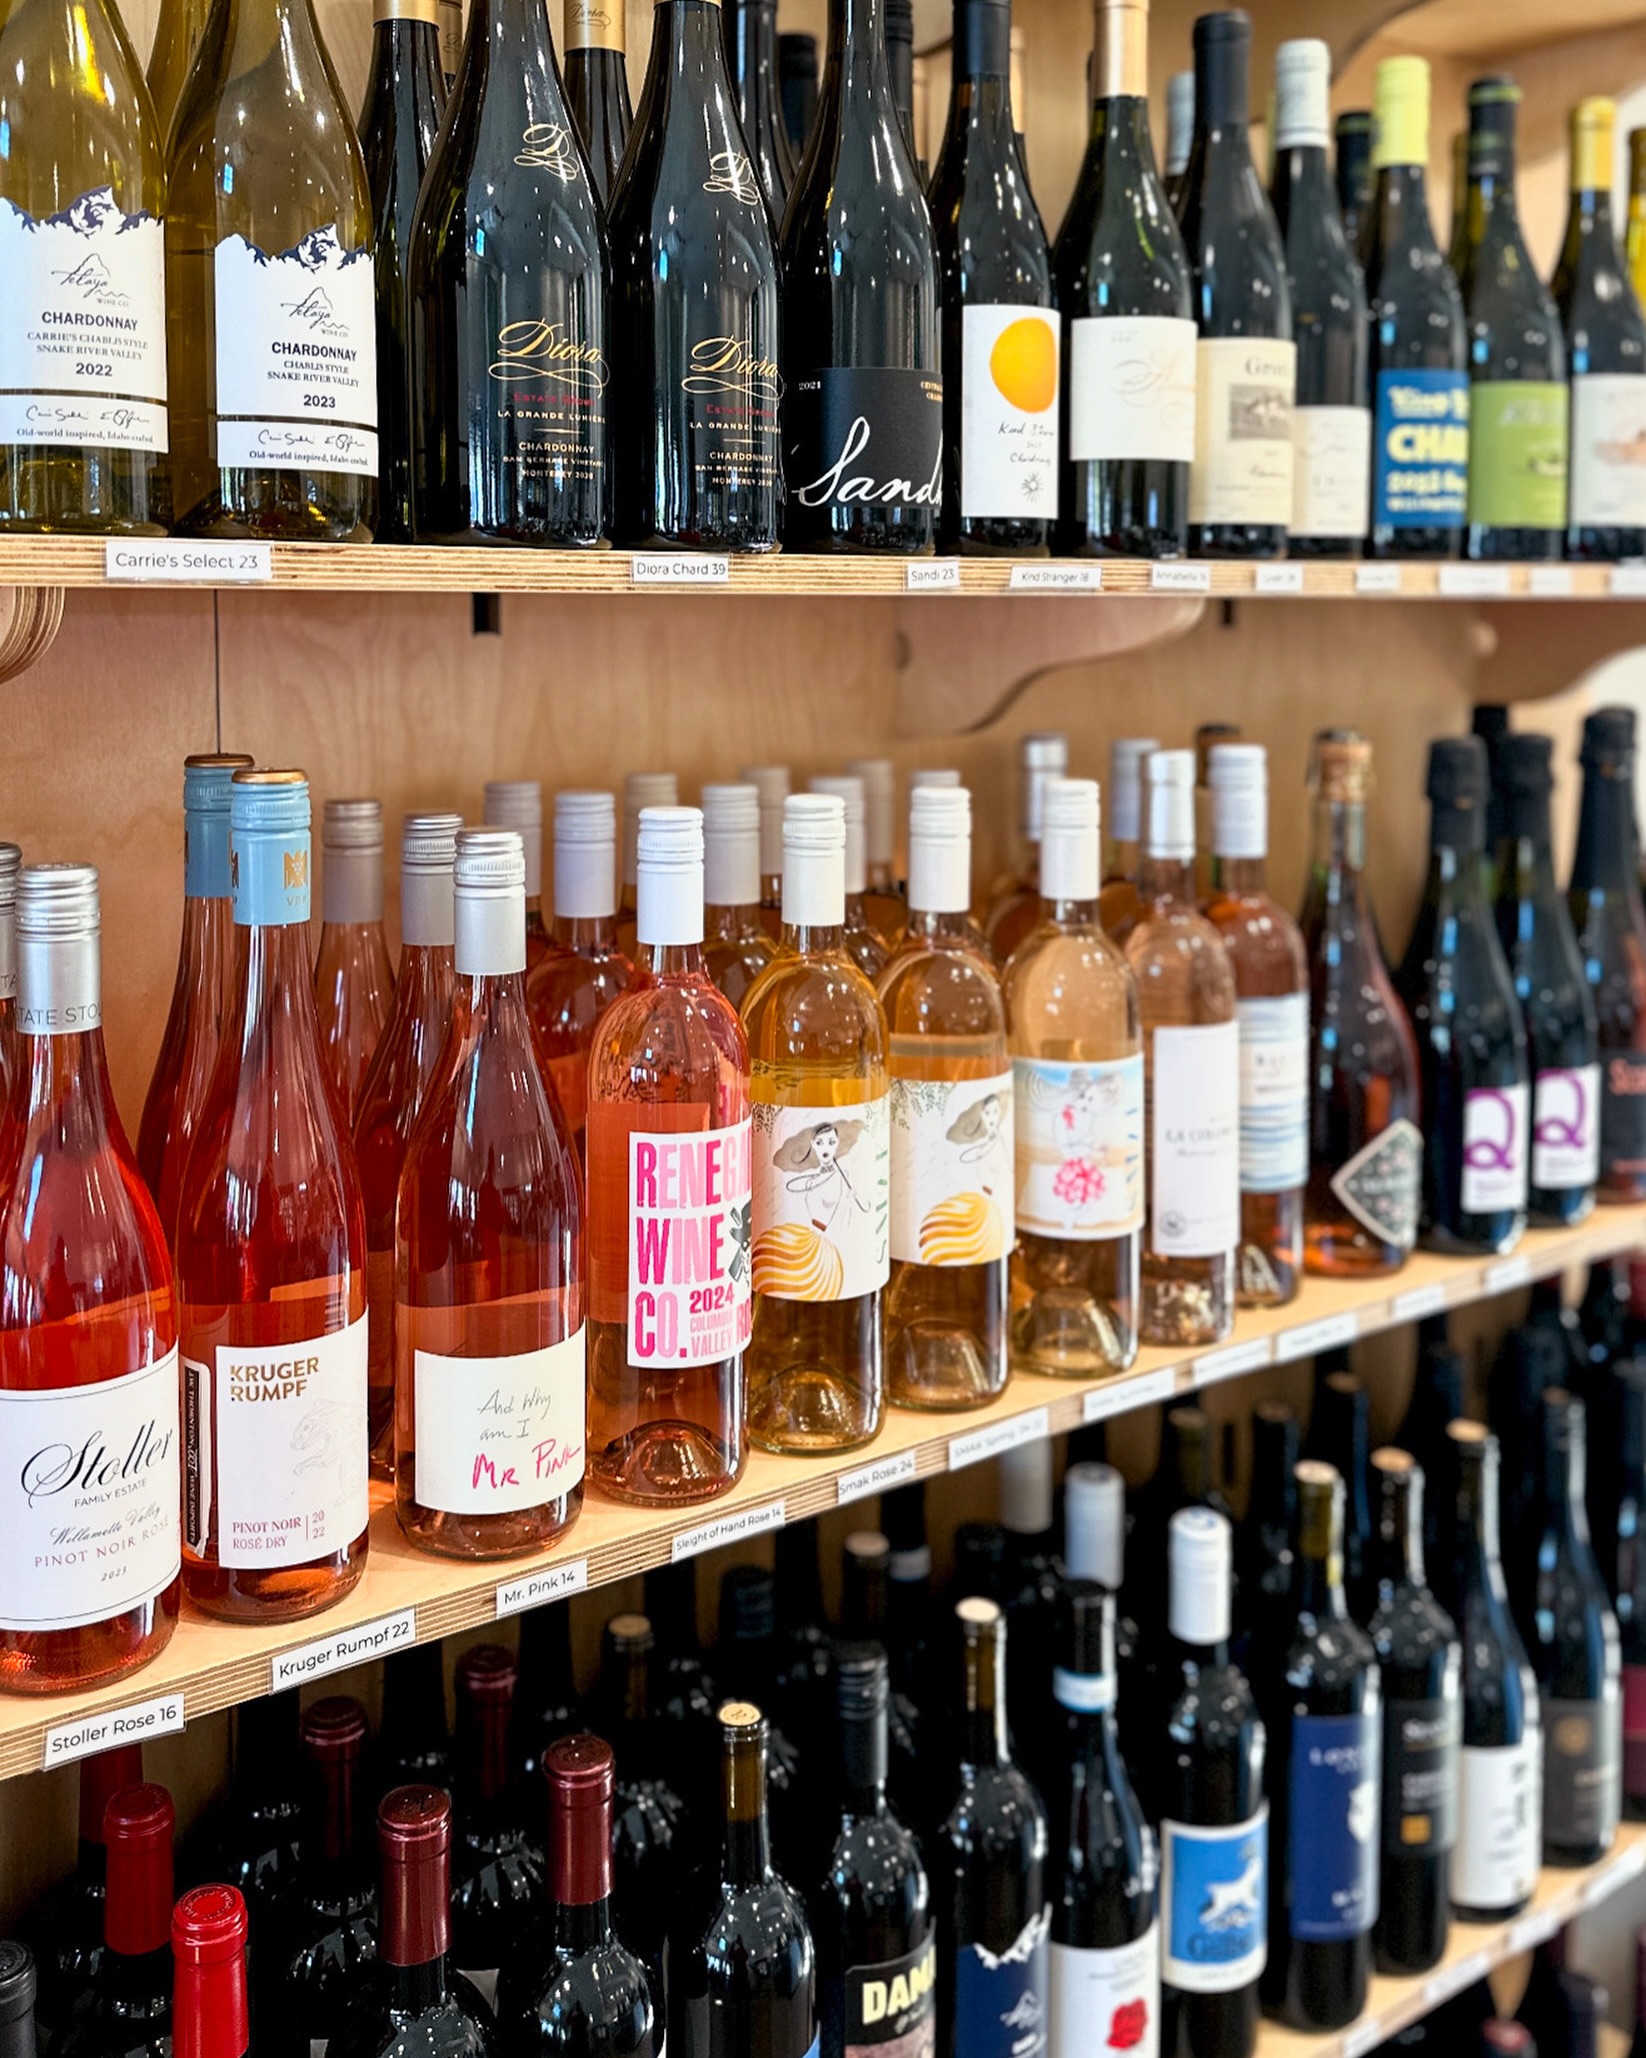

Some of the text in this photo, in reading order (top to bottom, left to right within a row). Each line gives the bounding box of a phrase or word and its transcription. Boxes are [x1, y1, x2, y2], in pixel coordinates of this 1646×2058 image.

[42, 311, 138, 331] CHARDONNAY
[37, 344, 143, 361] SNAKE RIVER VALLEY
[271, 341, 357, 362] CHARDONNAY
[492, 317, 608, 378] Diora
[75, 362, 113, 377] 2022
[284, 360, 324, 371] CHABLIS
[686, 335, 781, 391] Diora
[267, 371, 359, 388] SNAKE RIVER VALLEY
[799, 381, 821, 390] 2021
[303, 394, 336, 408] 2023
[498, 410, 511, 418] LA
[517, 411, 564, 420] GRANDE
[16, 428, 64, 438] Old-world
[66, 428, 106, 441] inspired,
[108, 431, 130, 442] Idaho
[708, 422, 750, 431] GRANDE
[249, 450, 292, 460] Old-world
[294, 452, 328, 463] inspired,
[518, 441, 595, 454] CHARDONNAY
[709, 452, 774, 464] CHARDONNAY
[115, 552, 258, 569] Carrie's Select 23
[637, 562, 726, 576] Diora Chard 39
[911, 568, 954, 582] Sandi 23
[635, 1212, 725, 1286] WINE
[689, 1282, 734, 1314] 2024
[634, 1290, 688, 1359] CO.
[691, 1328, 733, 1358] VALLEY
[229, 1356, 320, 1382] KRUGER
[229, 1379, 308, 1402] RUMPF
[479, 1386, 552, 1421] And Why
[479, 1418, 531, 1442] am I
[21, 1419, 173, 1510] Stoller
[839, 1459, 913, 1496] Smak Rose 24
[74, 1477, 147, 1509] FAMILY ESTATE
[50, 1500, 162, 1546] Willamette Valley
[232, 1516, 302, 1535] PINOT NOIR
[676, 1508, 781, 1552] Sleight of Hand Rose 14
[34, 1549, 88, 1568] PINOT
[95, 1536, 136, 1559] NOIR
[232, 1535, 288, 1550] ROSÉ DRY
[503, 1571, 577, 1606] Mr. Pink 14
[278, 1621, 411, 1680] Kruger Rumpf 22
[51, 1704, 178, 1754] Stoller Rose 16
